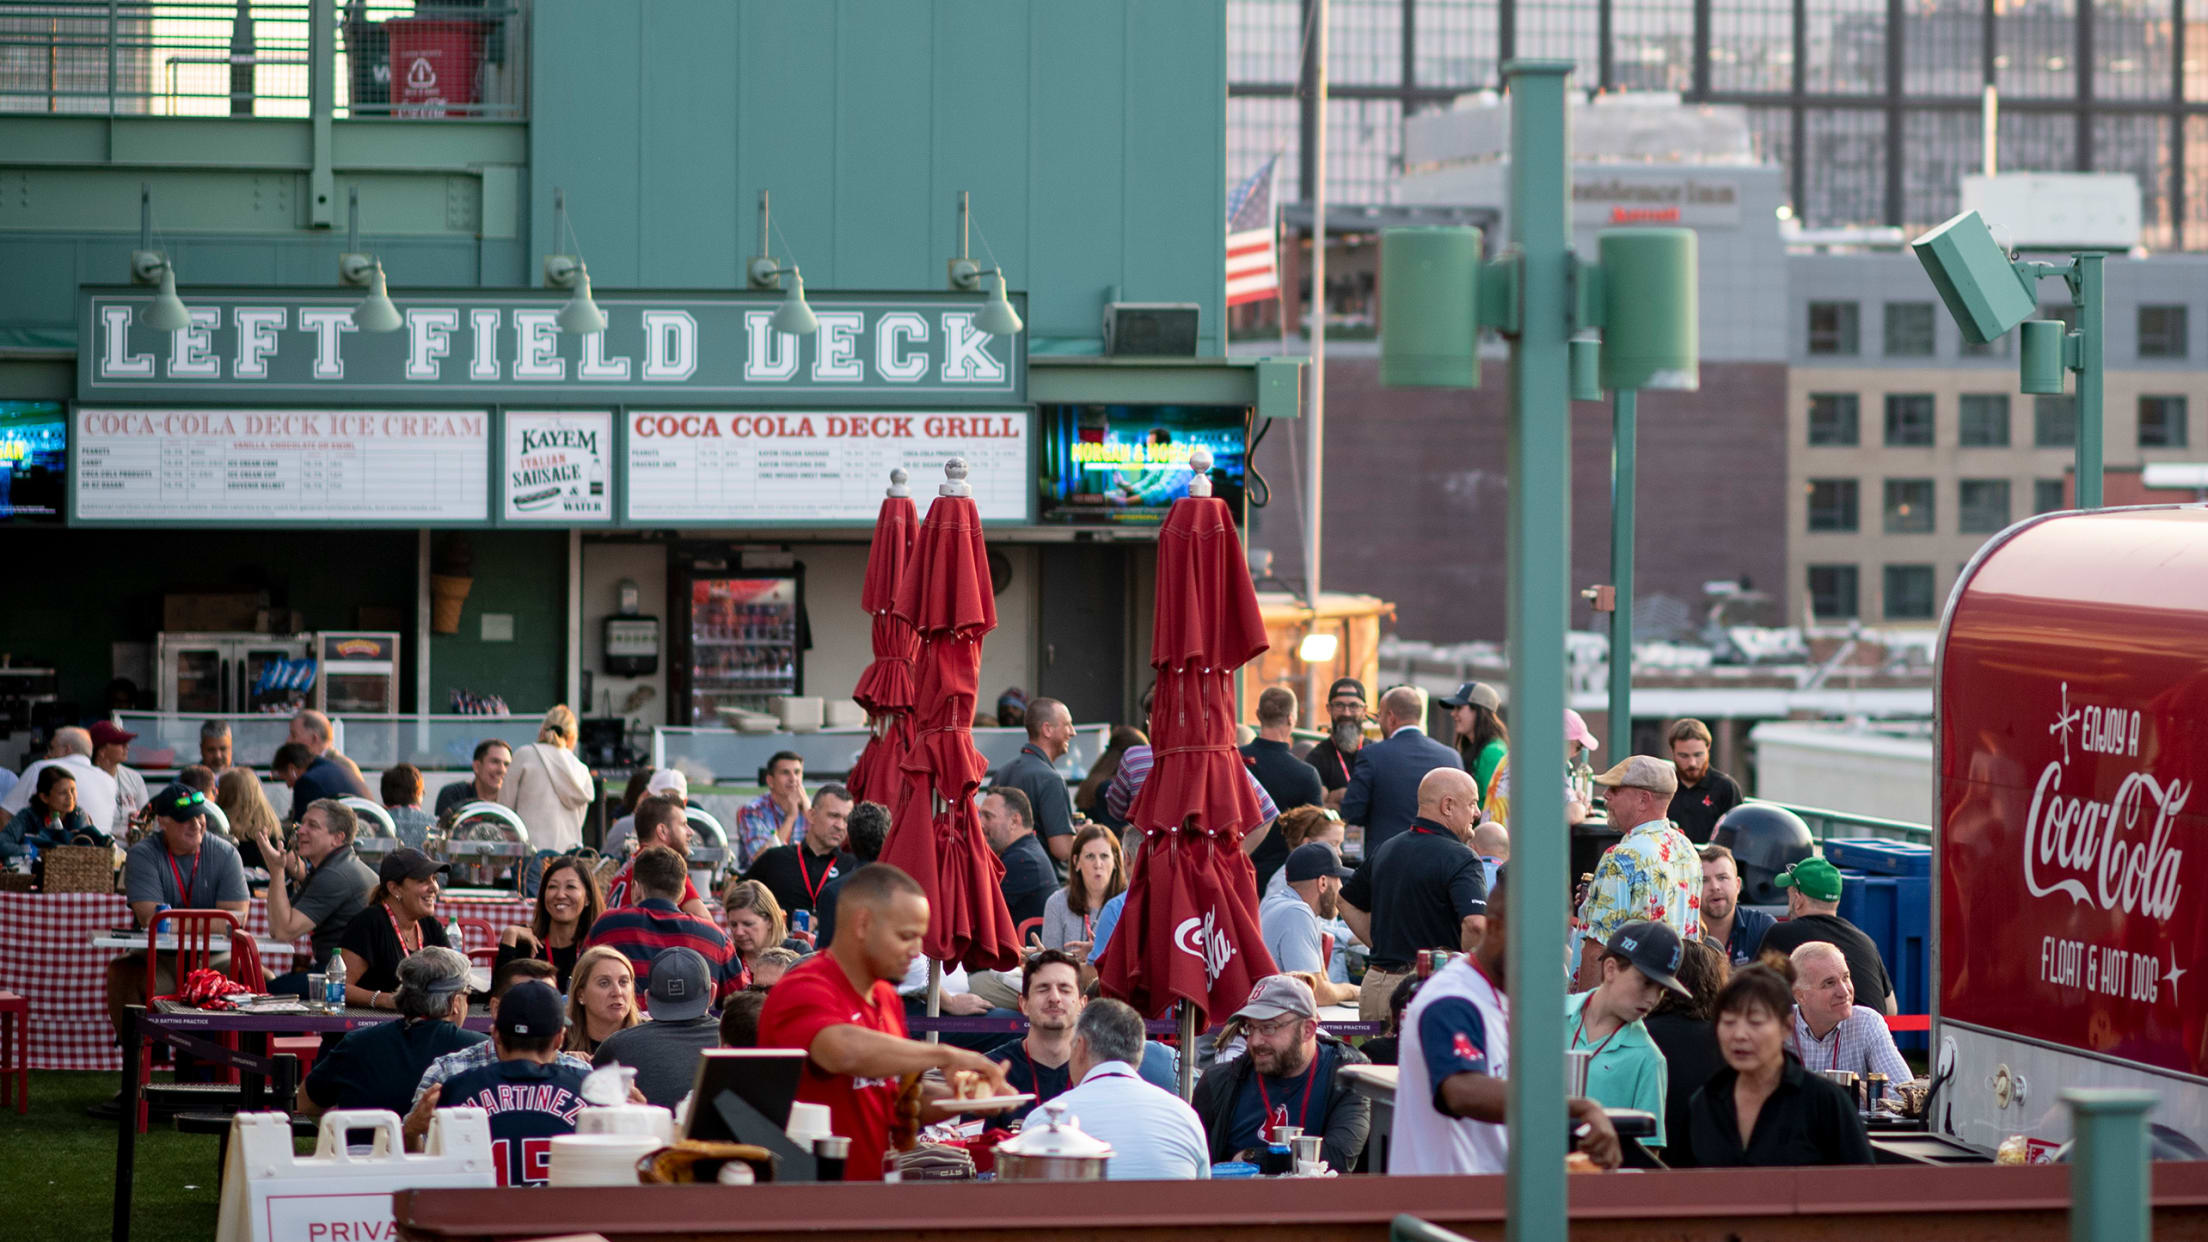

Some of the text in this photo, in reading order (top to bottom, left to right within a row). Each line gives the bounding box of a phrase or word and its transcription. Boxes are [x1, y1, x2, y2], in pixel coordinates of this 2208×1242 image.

[101, 305, 1006, 382] LEFT FIELD DECK
[83, 412, 483, 438] COCA-COLA DECK ICE CREAM
[634, 415, 1020, 438] COCA COLA DECK GRILL
[521, 429, 598, 455] KAYEM
[1071, 442, 1131, 463] MORGAN
[1133, 443, 1145, 462] &
[520, 453, 566, 470] ITALIAN
[513, 464, 581, 488] SAUSAGE
[569, 485, 579, 496] &
[563, 501, 602, 512] WATER
[2081, 705, 2141, 757] ENJOY A
[2024, 760, 2193, 921] Coca-Cola
[2041, 935, 2160, 1004] FLOAT & HOT DOG
[308, 1221, 398, 1242] PRIVA
